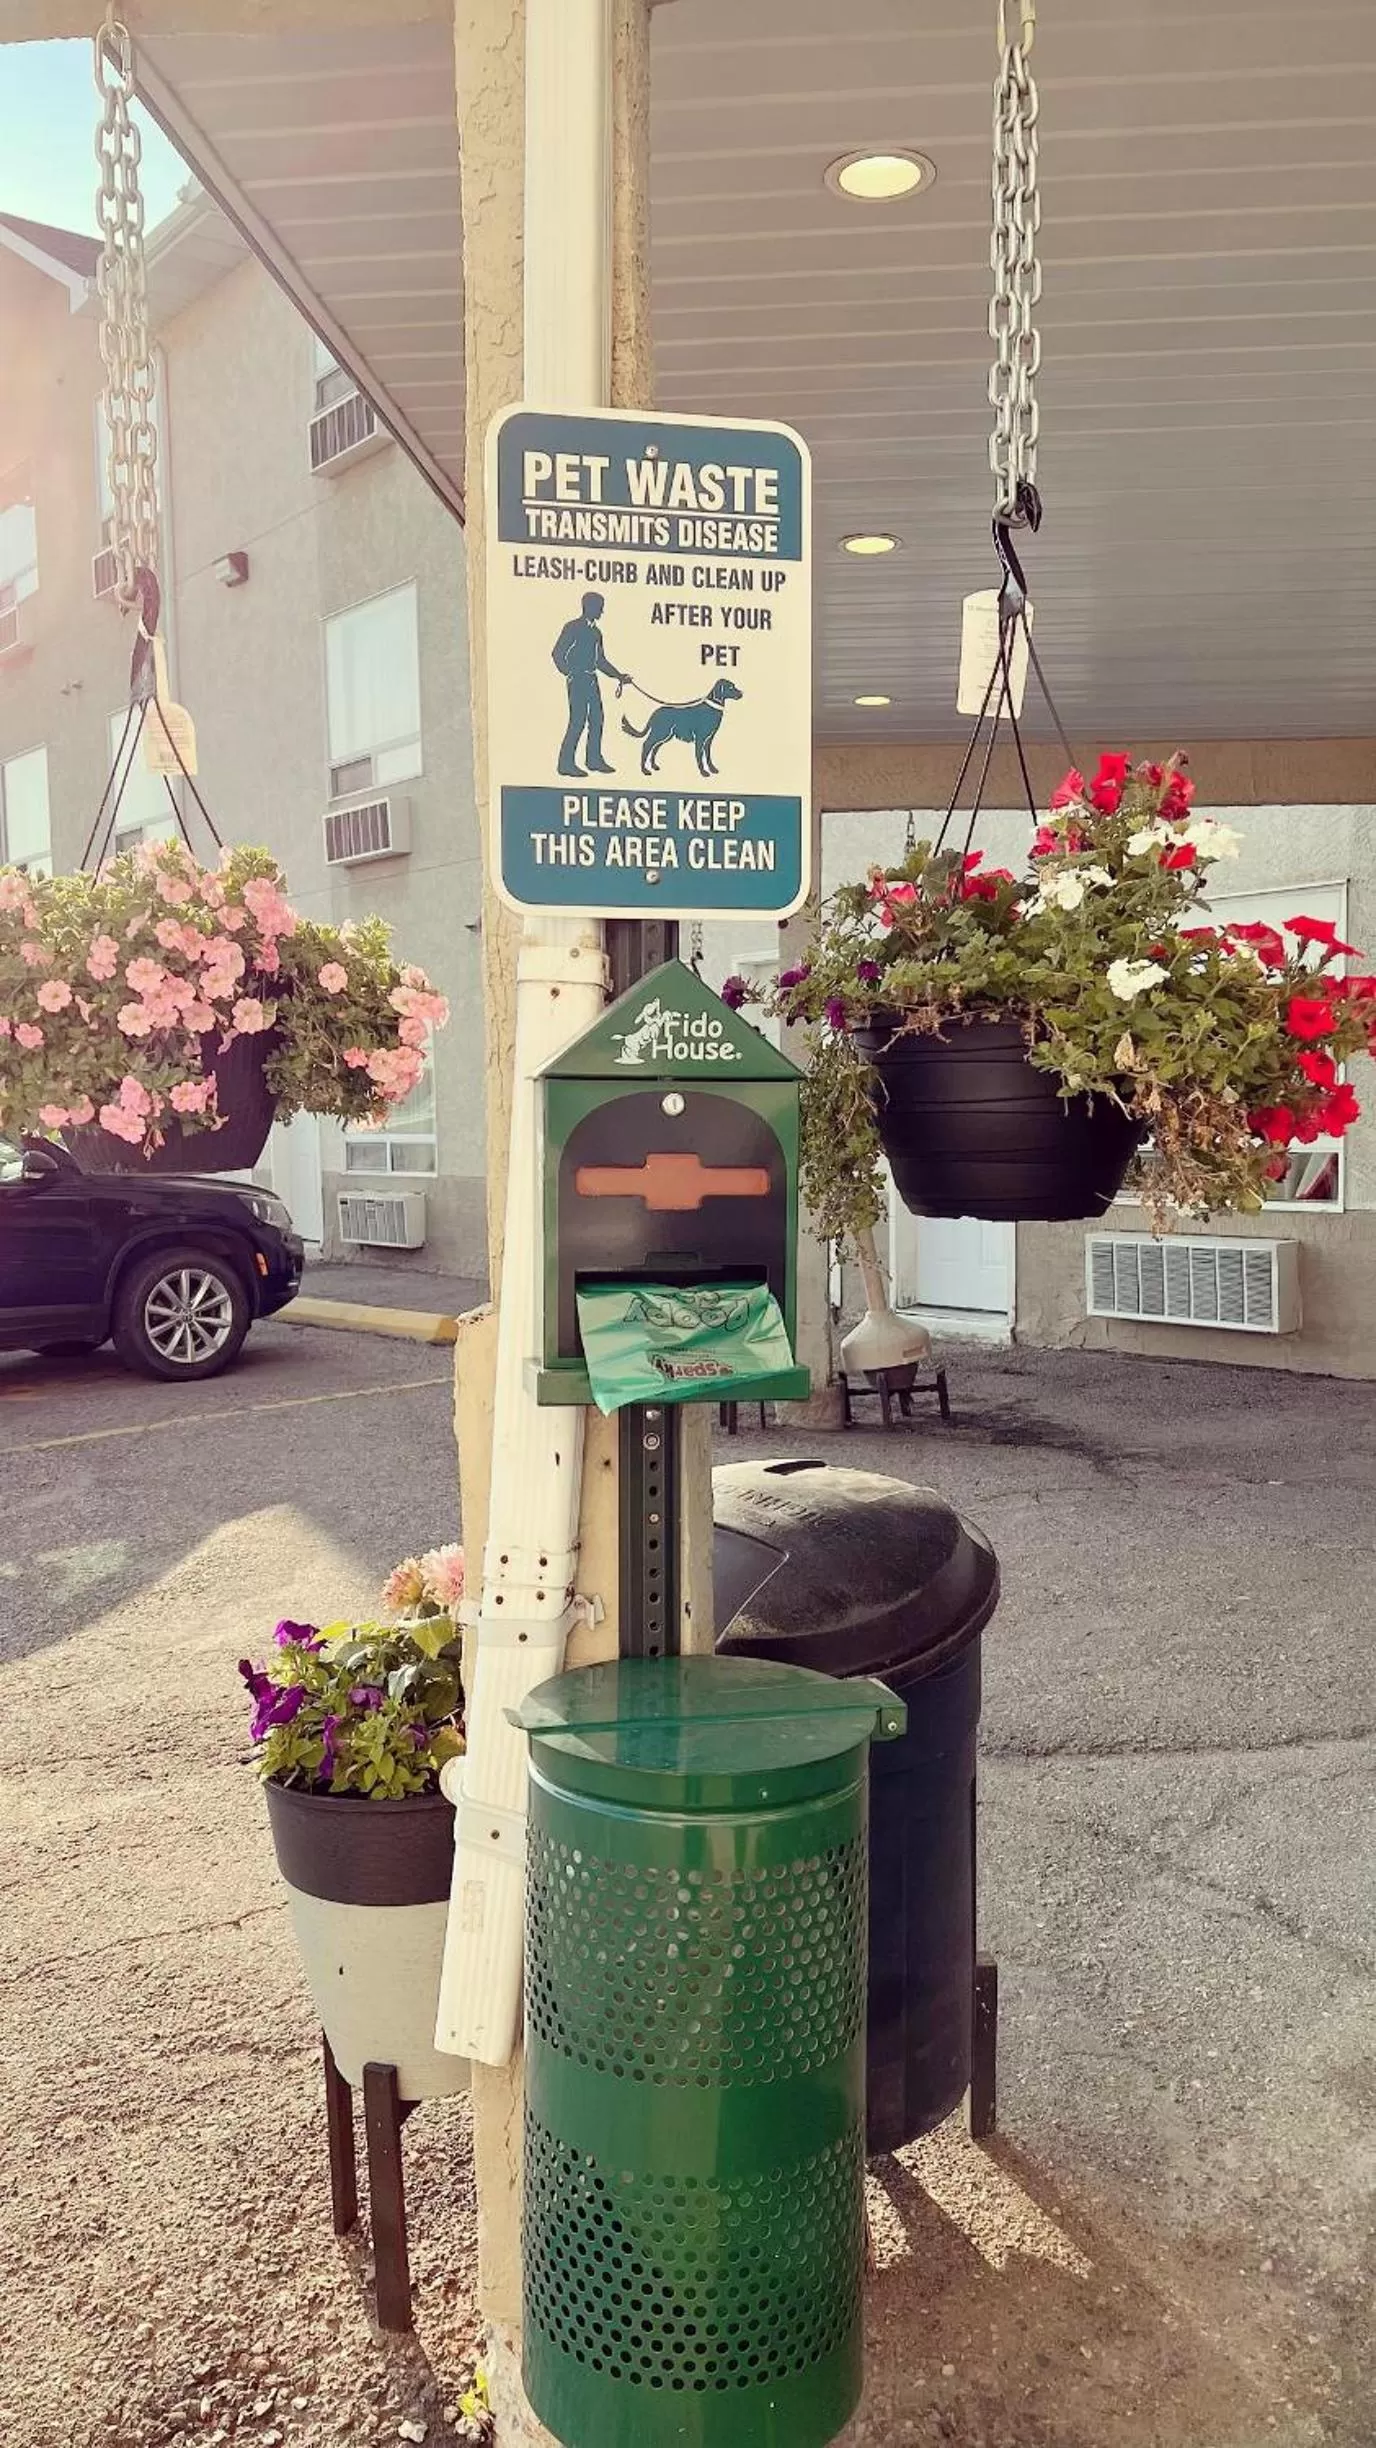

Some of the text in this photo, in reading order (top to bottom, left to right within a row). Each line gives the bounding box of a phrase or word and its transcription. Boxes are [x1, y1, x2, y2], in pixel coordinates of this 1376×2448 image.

[522, 451, 779, 515] PET WASTE
[525, 509, 778, 553] TRANSMITS DISEASE
[513, 555, 786, 592] LEASH-CURB AND CLEAN UP
[651, 602, 772, 630] AFTER YOUR
[701, 644, 740, 667] PET
[563, 796, 746, 832] PLEASE KEEP
[530, 834, 776, 871] THIS AREA CLEAN
[664, 1011, 723, 1038] Fido
[652, 1034, 743, 1060] House.
